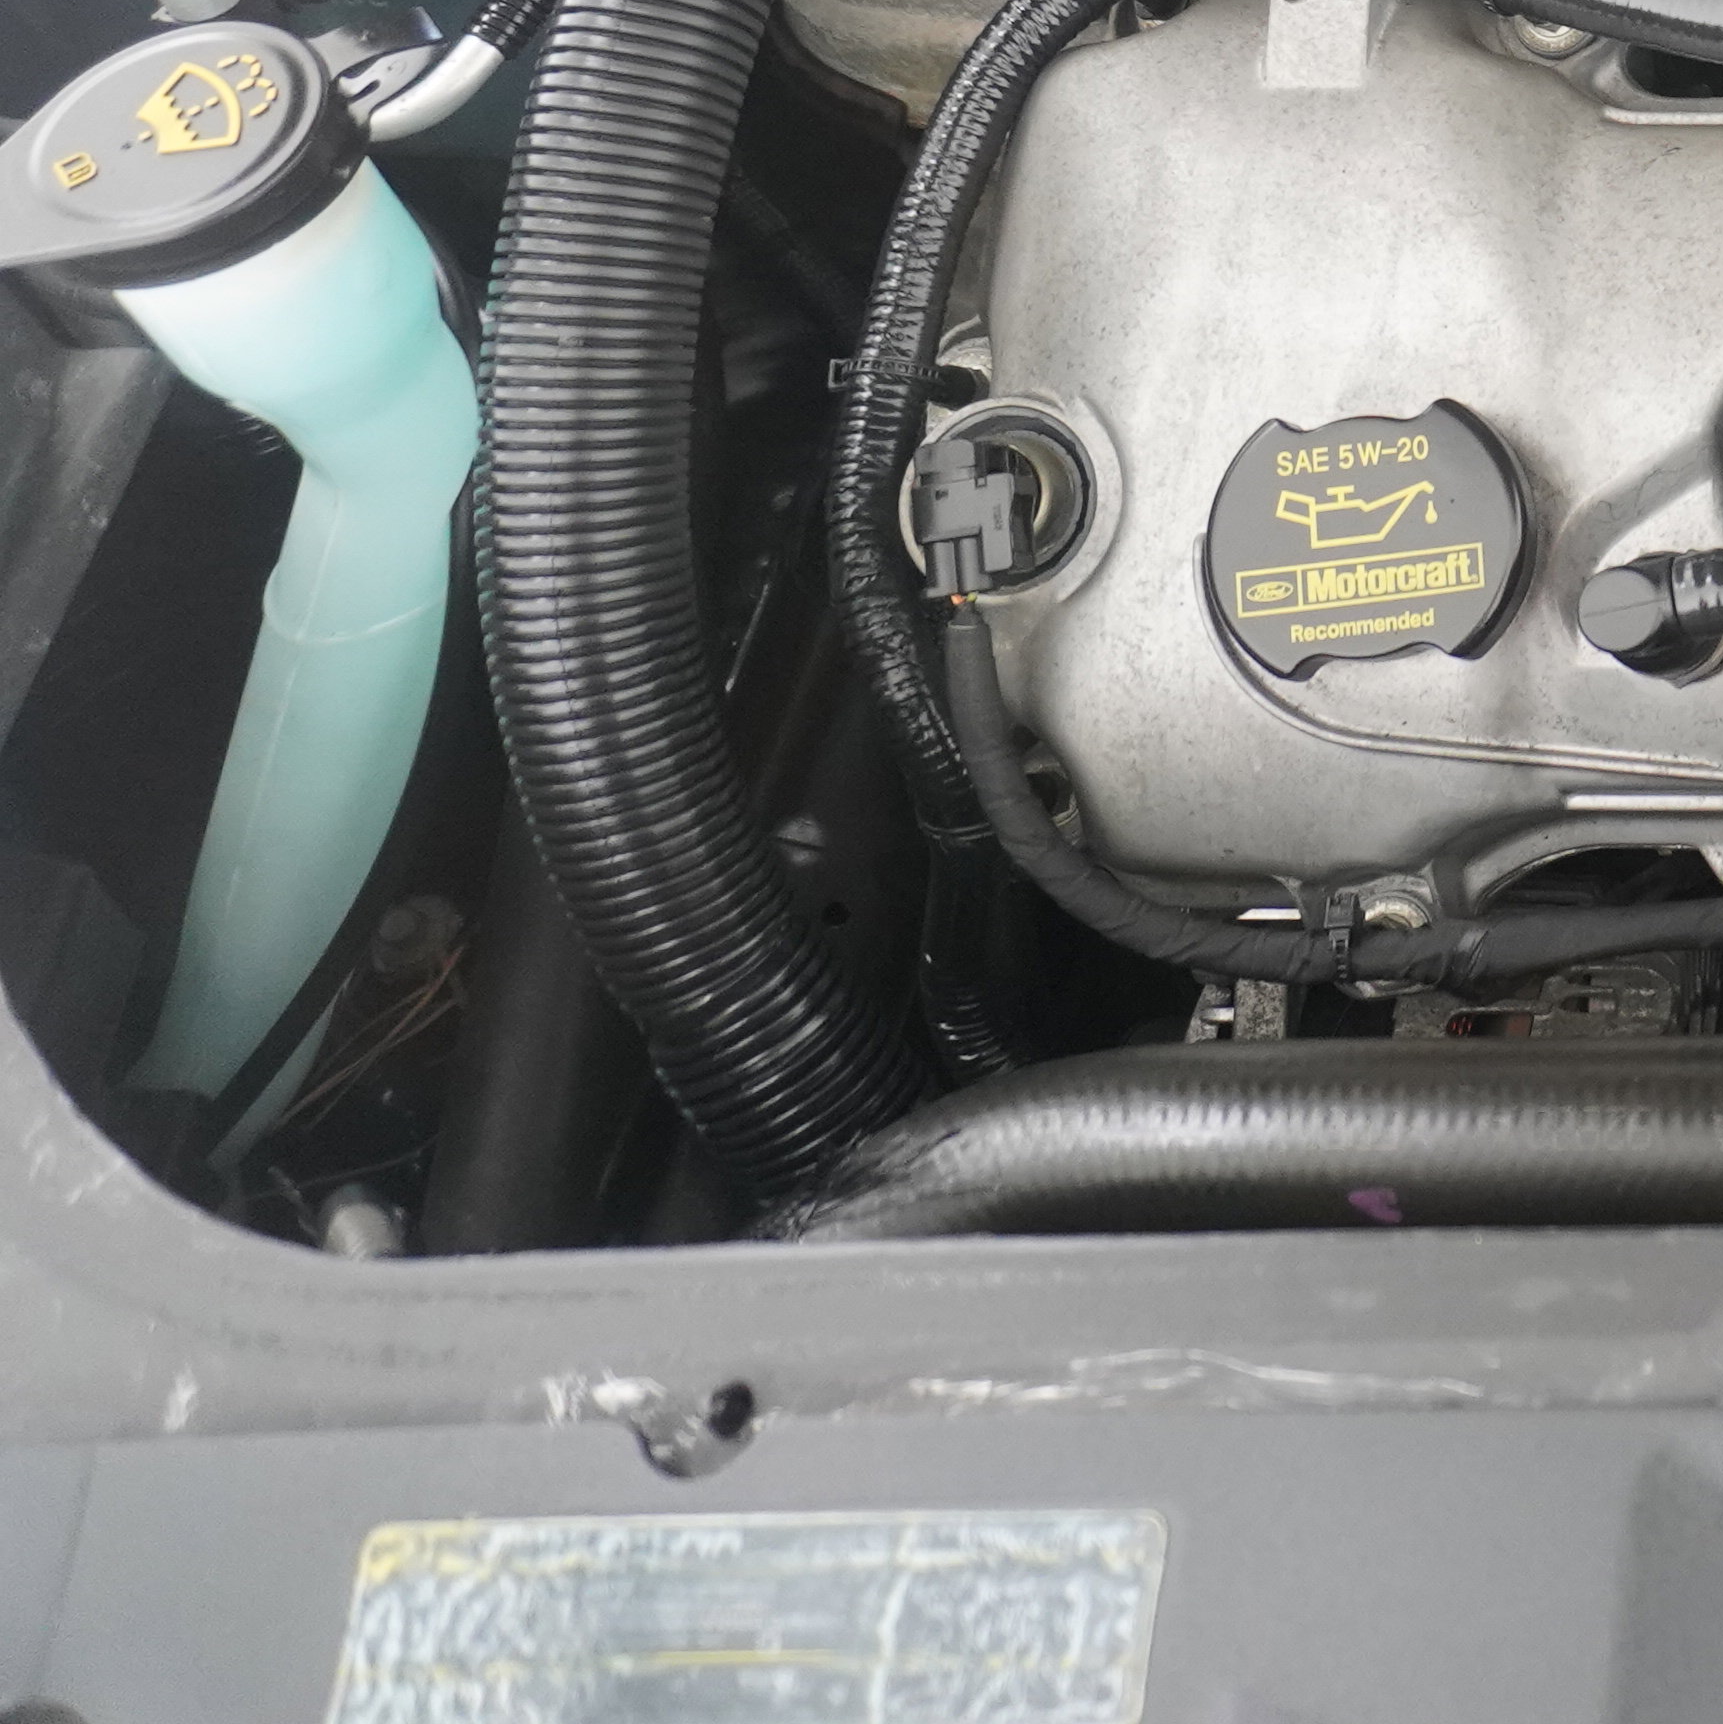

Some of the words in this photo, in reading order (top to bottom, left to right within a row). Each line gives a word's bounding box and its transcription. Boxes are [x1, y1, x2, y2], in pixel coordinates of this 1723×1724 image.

[1275, 446, 1330, 477] SAE
[1338, 434, 1430, 470] 5W-20
[1247, 581, 1294, 603] Ford
[1306, 550, 1473, 604] Motorcraft
[1290, 607, 1435, 643] Recommended
